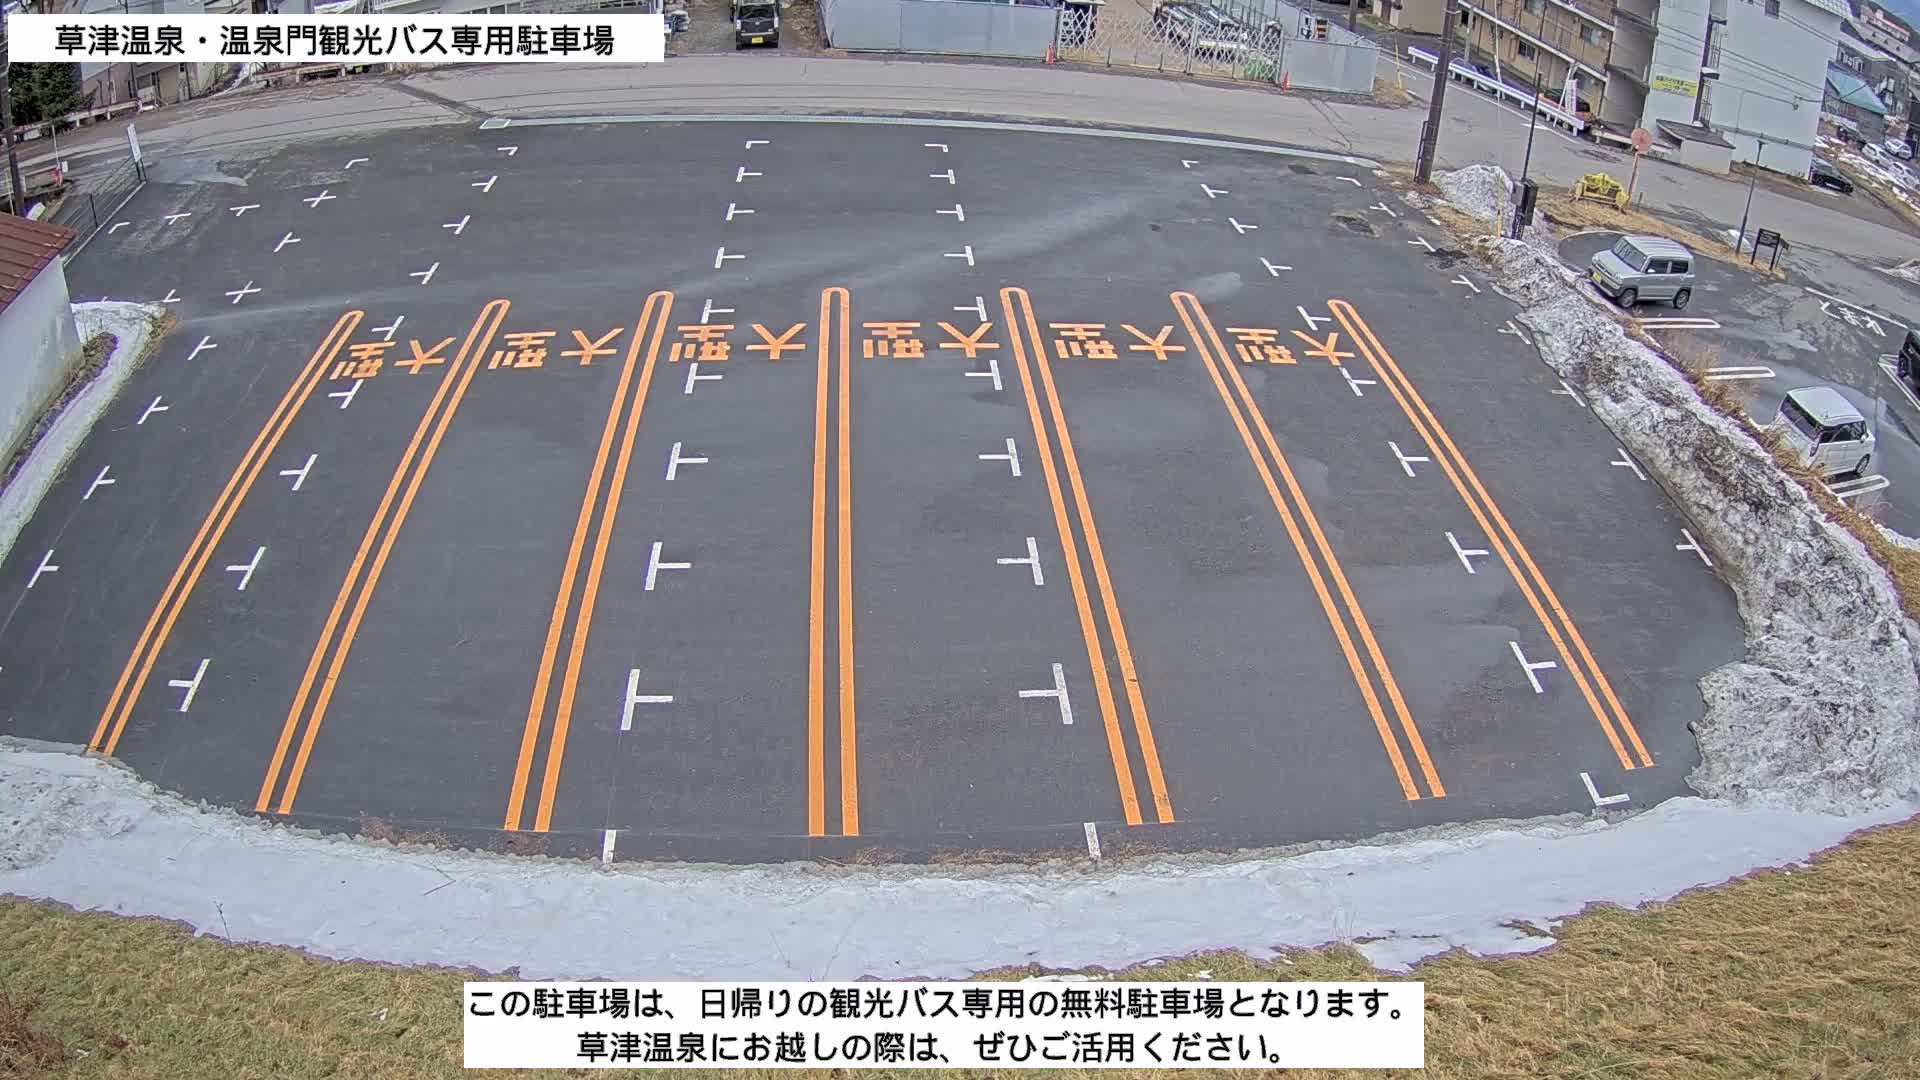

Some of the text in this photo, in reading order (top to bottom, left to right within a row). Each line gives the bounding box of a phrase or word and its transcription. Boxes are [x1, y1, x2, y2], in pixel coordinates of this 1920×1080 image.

[330, 337, 456, 380] 大型
[489, 328, 625, 369] 大型
[669, 322, 806, 361] 大型
[862, 321, 1000, 359] 大型
[1048, 322, 1186, 361] 大型
[1225, 326, 1356, 367] 大型
